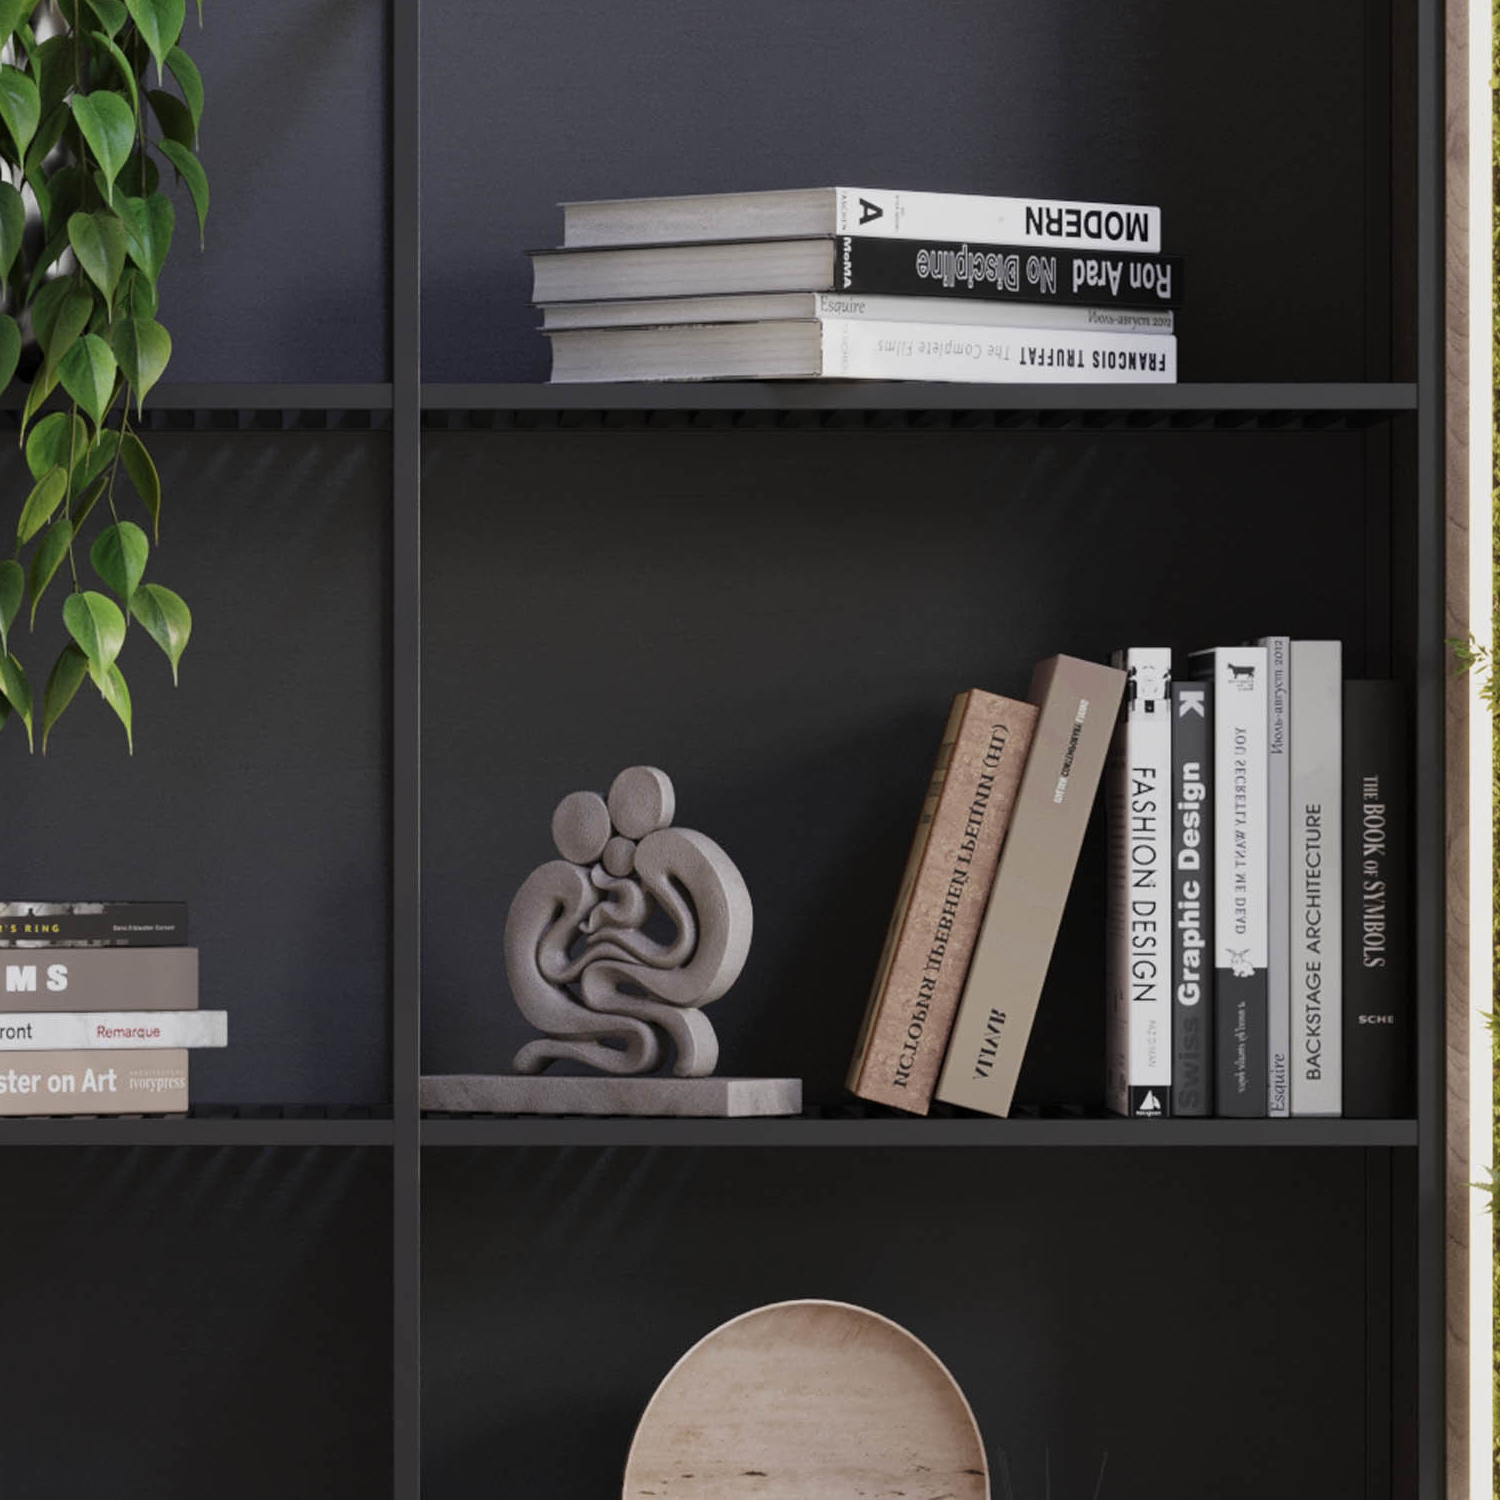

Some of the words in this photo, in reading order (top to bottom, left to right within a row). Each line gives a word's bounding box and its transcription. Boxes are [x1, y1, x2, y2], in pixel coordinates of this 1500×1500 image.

[859, 198, 883, 226] A
[1025, 206, 1150, 242] MODERN
[843, 237, 852, 289] MoMA
[916, 244, 1020, 292] Discipline
[1027, 256, 1057, 294] No
[1073, 258, 1122, 296] Arad
[1129, 263, 1172, 299] Ron
[820, 297, 866, 315] Esquire
[918, 340, 982, 361] Complete
[988, 345, 1011, 361] The
[1020, 347, 1085, 368] TRUFFAT
[1093, 350, 1167, 372] FRANCOIS
[1275, 640, 1284, 666] 2012
[1179, 691, 1205, 718] K
[1363, 775, 1378, 800] THE
[1131, 767, 1156, 888] FASHION
[1177, 762, 1206, 870] Design
[1363, 803, 1386, 857] BOOK
[1305, 803, 1321, 954] ARCHITECTURE
[1363, 859, 1378, 877] OF
[24, 923, 60, 933] RING
[1363, 880, 1386, 968] SYMBOLS
[1131, 901, 1157, 1001] DESIGN
[1177, 880, 1205, 1006] Graphic
[96, 1025, 161, 1040] Remarque
[1306, 961, 1321, 1080] BACKSTAGE
[1358, 1015, 1394, 1024] SCHE
[47, 1074, 80, 1093] on
[81, 1068, 117, 1093] Art
[1269, 1053, 1287, 1112] Esquire
